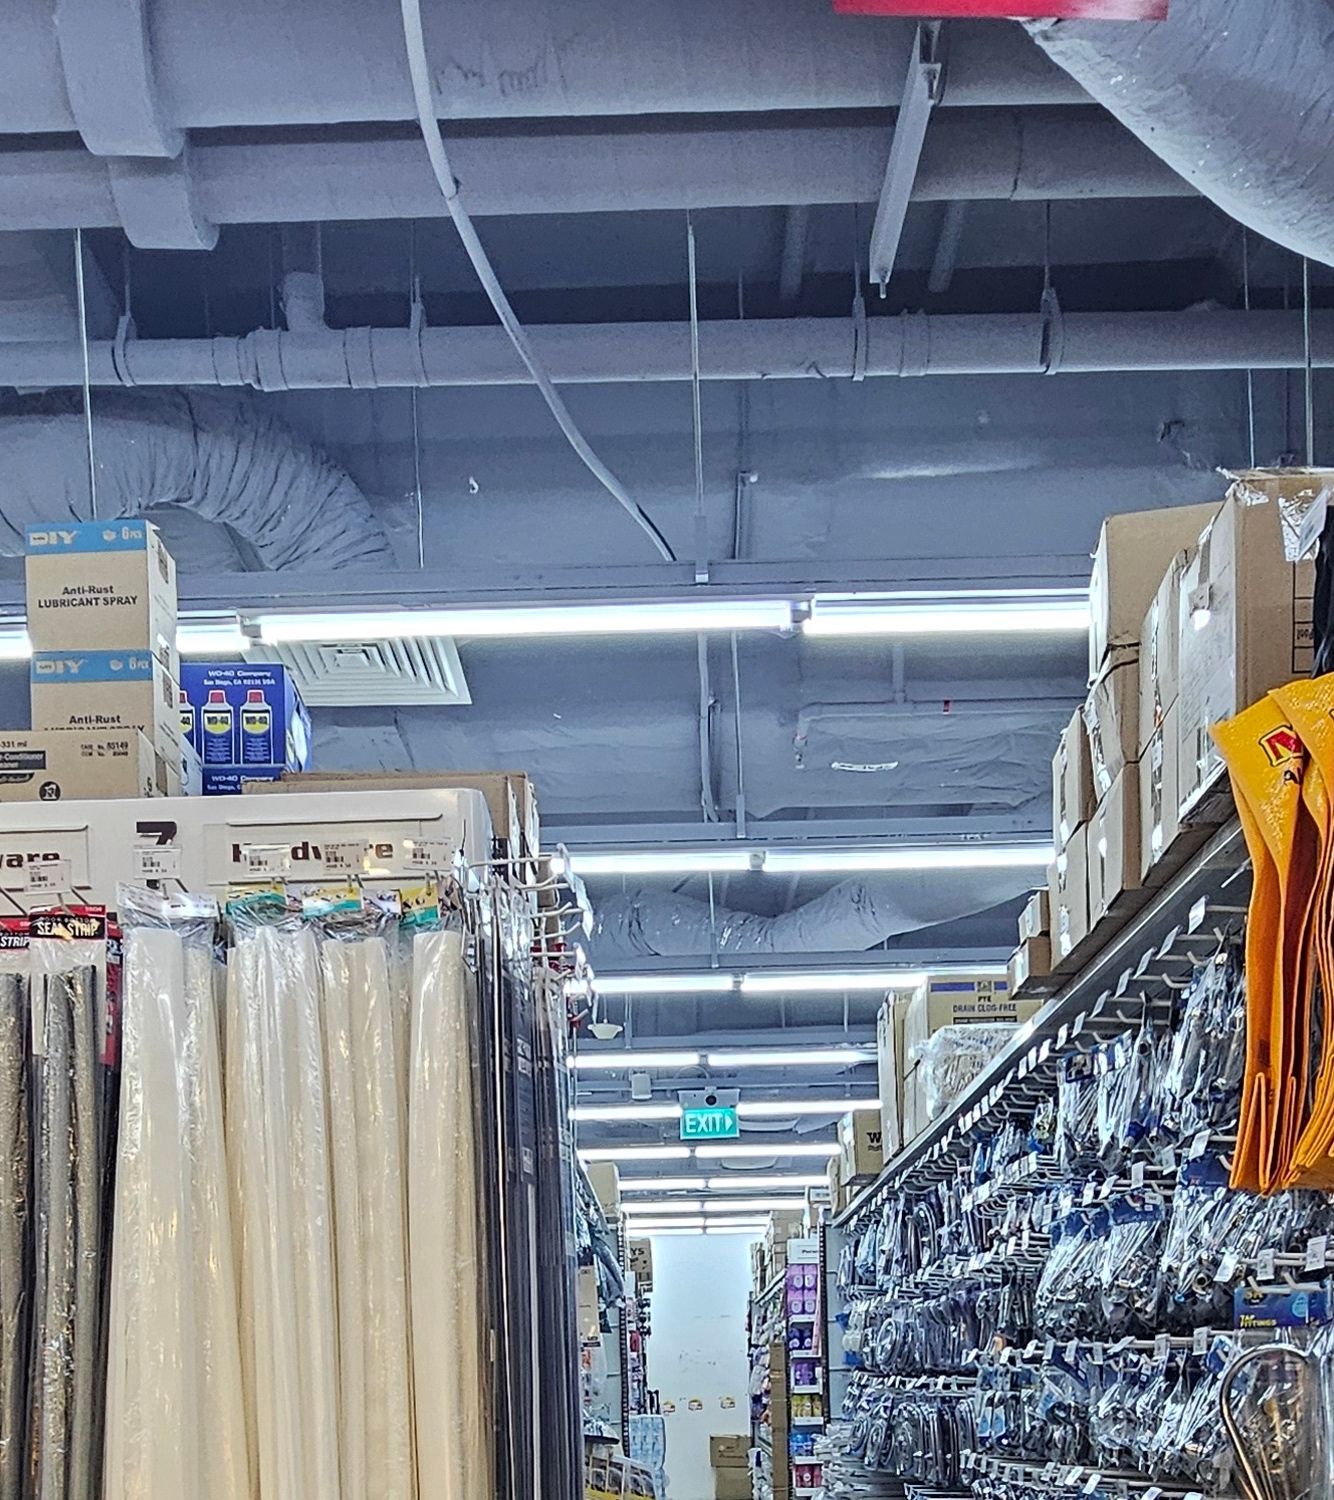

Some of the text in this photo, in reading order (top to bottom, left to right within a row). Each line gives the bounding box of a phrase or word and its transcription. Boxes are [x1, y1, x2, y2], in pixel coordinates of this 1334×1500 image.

[61, 584, 115, 596] Anti-Rust
[37, 595, 138, 609] LUBRICANT SPRAY
[68, 714, 122, 725] Anti-Rust
[36, 919, 98, 937] SEAL STRIP
[0, 933, 29, 948] STRIP
[684, 1113, 724, 1134] EXIT
